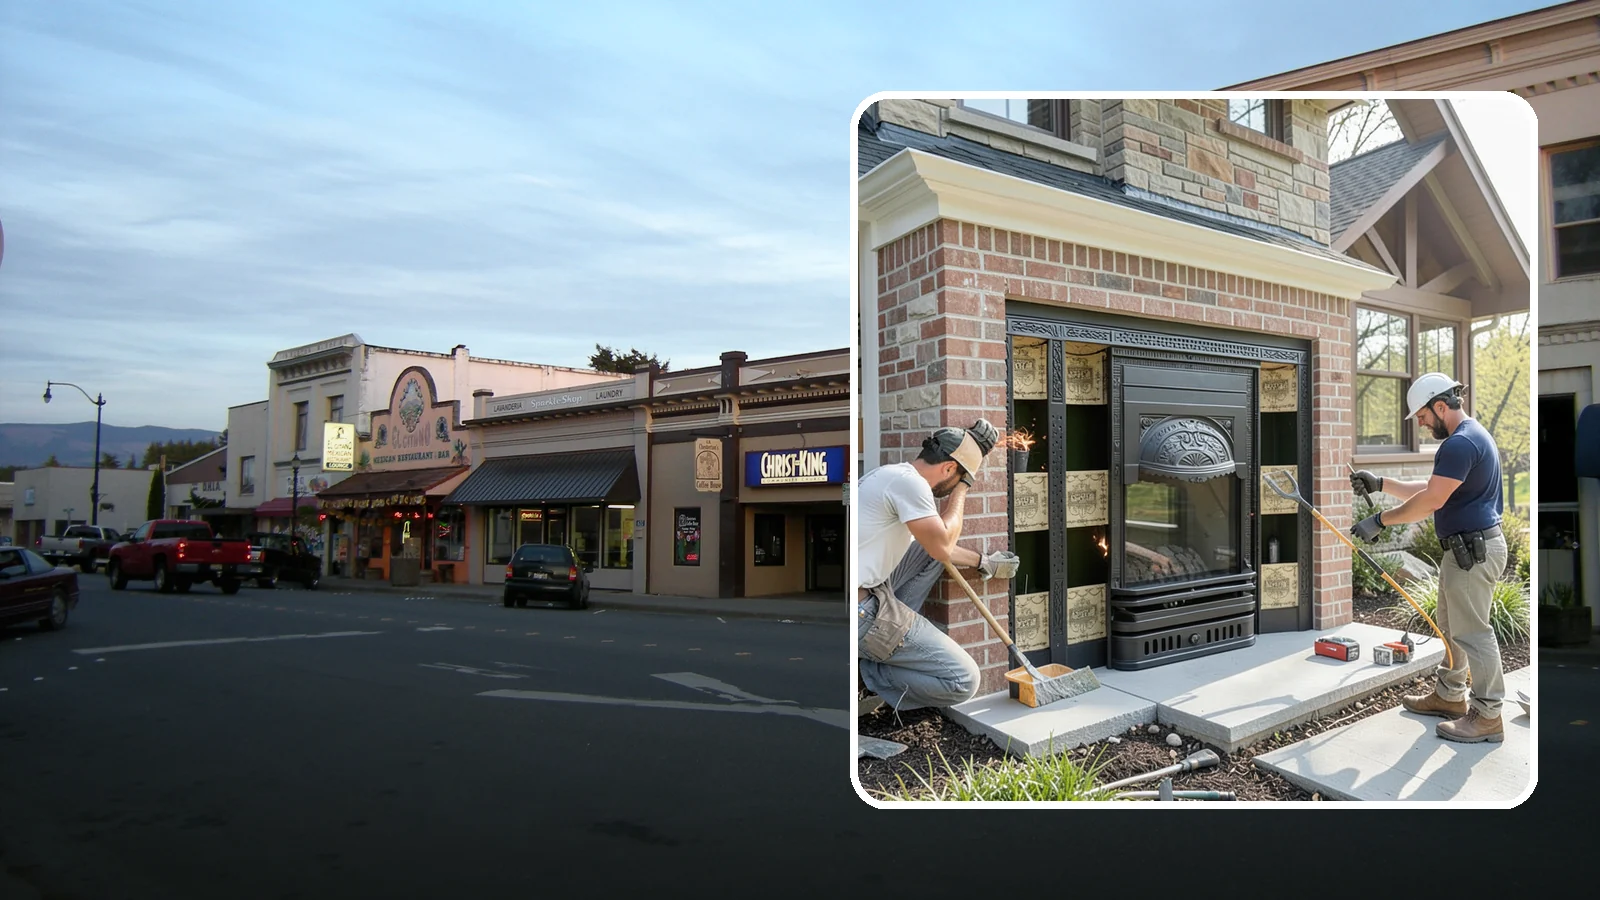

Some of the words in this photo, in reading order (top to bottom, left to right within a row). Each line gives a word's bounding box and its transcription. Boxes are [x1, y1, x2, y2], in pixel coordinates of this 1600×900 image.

[494, 402, 522, 412] LAVANDERIA
[562, 394, 582, 405] Shop
[595, 389, 623, 400] LAUNDRY
[373, 454, 396, 464] MEXICAN
[397, 451, 433, 462] RESTAURANT
[437, 450, 450, 459] BAR
